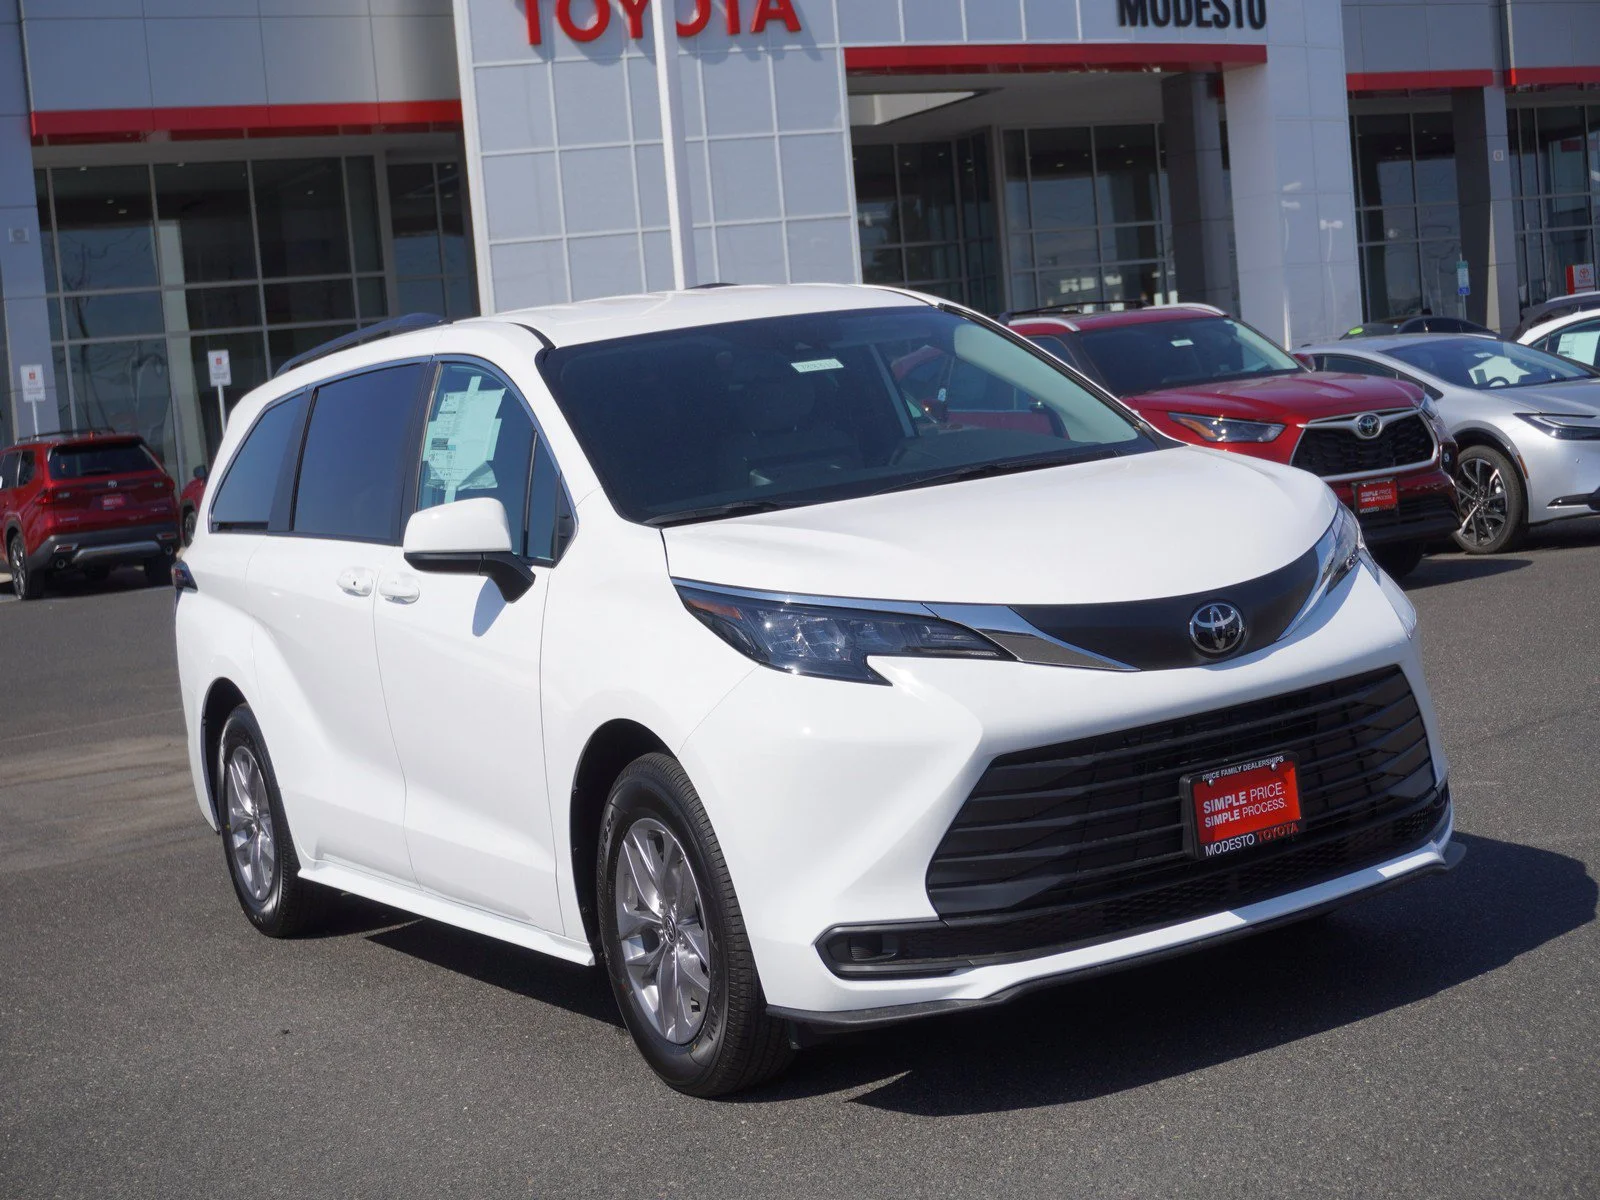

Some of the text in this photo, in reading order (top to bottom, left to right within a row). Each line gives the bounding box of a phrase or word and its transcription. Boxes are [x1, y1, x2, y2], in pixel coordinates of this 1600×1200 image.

[1118, 0, 1267, 30] MODESTO
[1202, 756, 1284, 781] PRICE FAMILY DEALERSHIPS
[1203, 782, 1286, 814] SIMPLE PRICE.
[1204, 798, 1288, 828] SIMPLE PROCESS.
[1205, 822, 1299, 857] MODESTO TOYOTA
